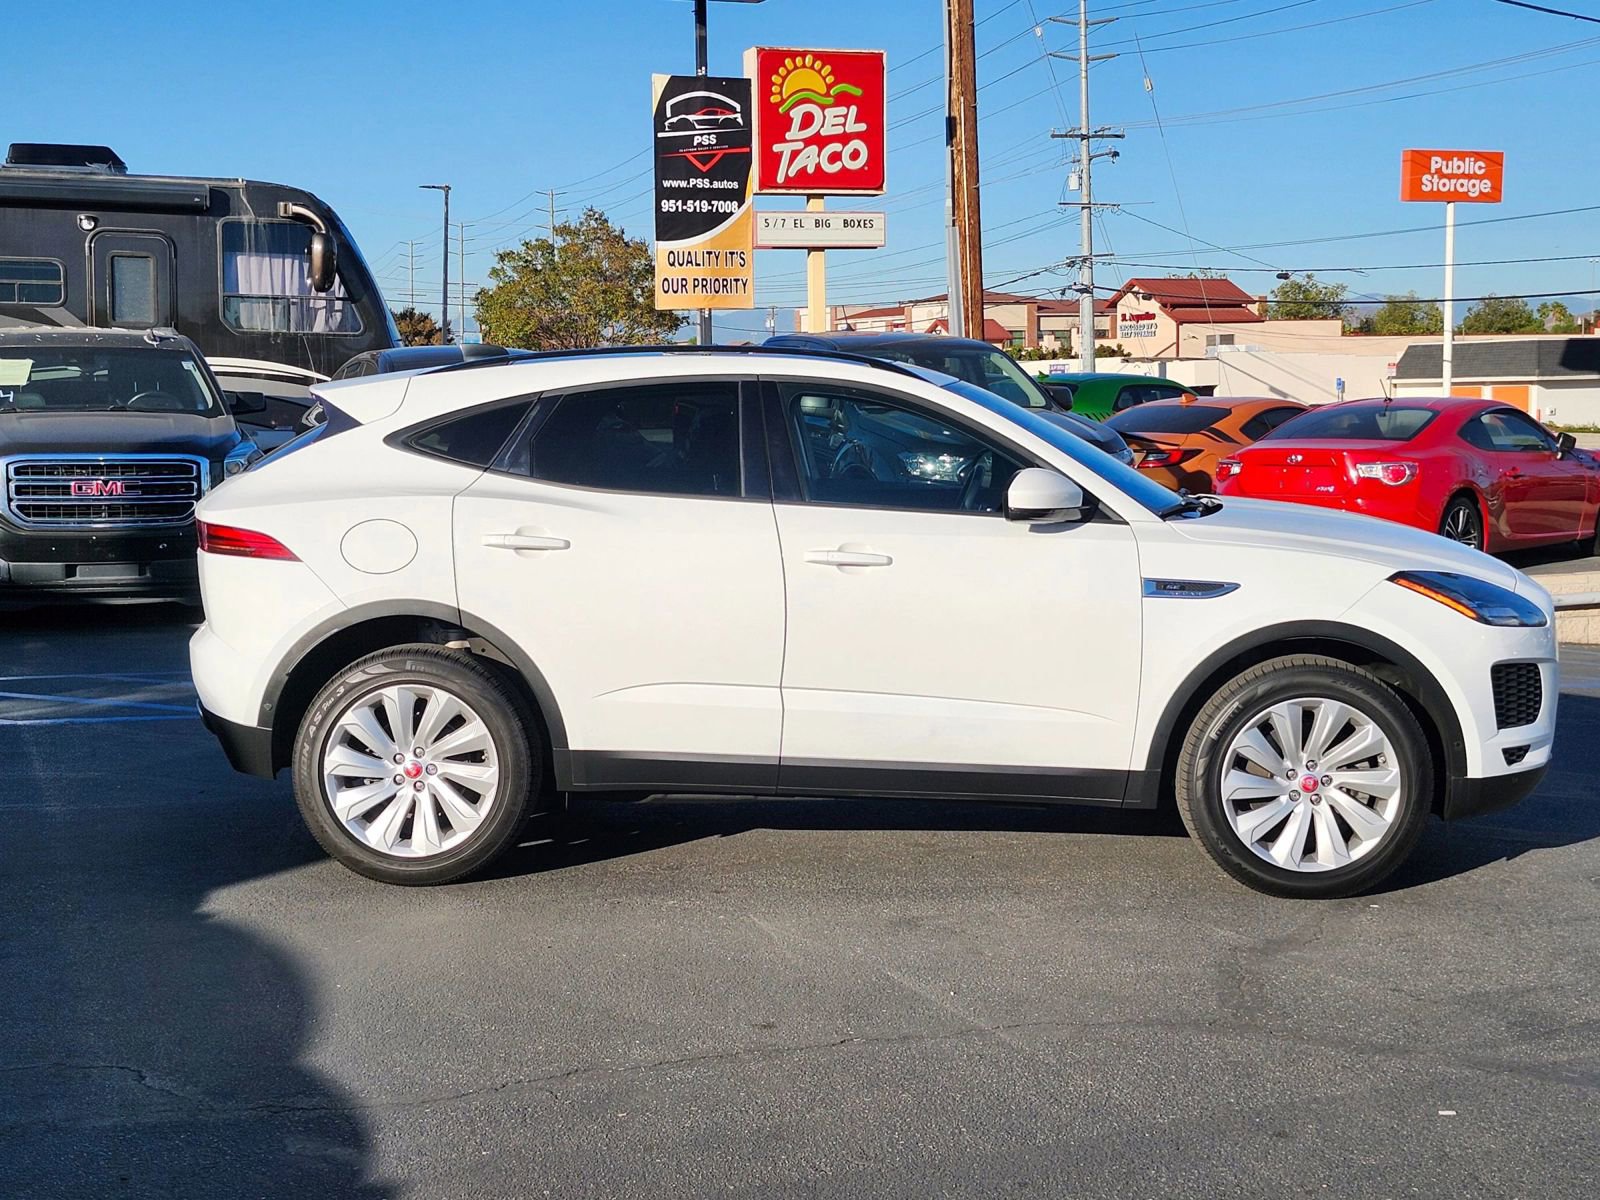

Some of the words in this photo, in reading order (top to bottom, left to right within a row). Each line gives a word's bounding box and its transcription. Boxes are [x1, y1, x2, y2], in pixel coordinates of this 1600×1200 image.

[785, 103, 867, 141] DEL
[693, 134, 717, 146] PSS
[772, 139, 868, 184] TACO
[1430, 156, 1486, 175] Public
[662, 178, 739, 190] www.PSS.autos
[1420, 174, 1491, 197] Storage
[661, 199, 739, 213] 951-519-7008
[794, 219, 805, 228] EL
[814, 219, 831, 228] BIG
[843, 219, 874, 228] BOXES
[667, 250, 719, 267] QUALITY
[724, 250, 746, 267] IT'S
[661, 278, 688, 294] OUR
[693, 278, 748, 295] PRIORITY
[70, 480, 141, 496] GMC
[308, 711, 323, 738] AS
[336, 685, 345, 697] 3
